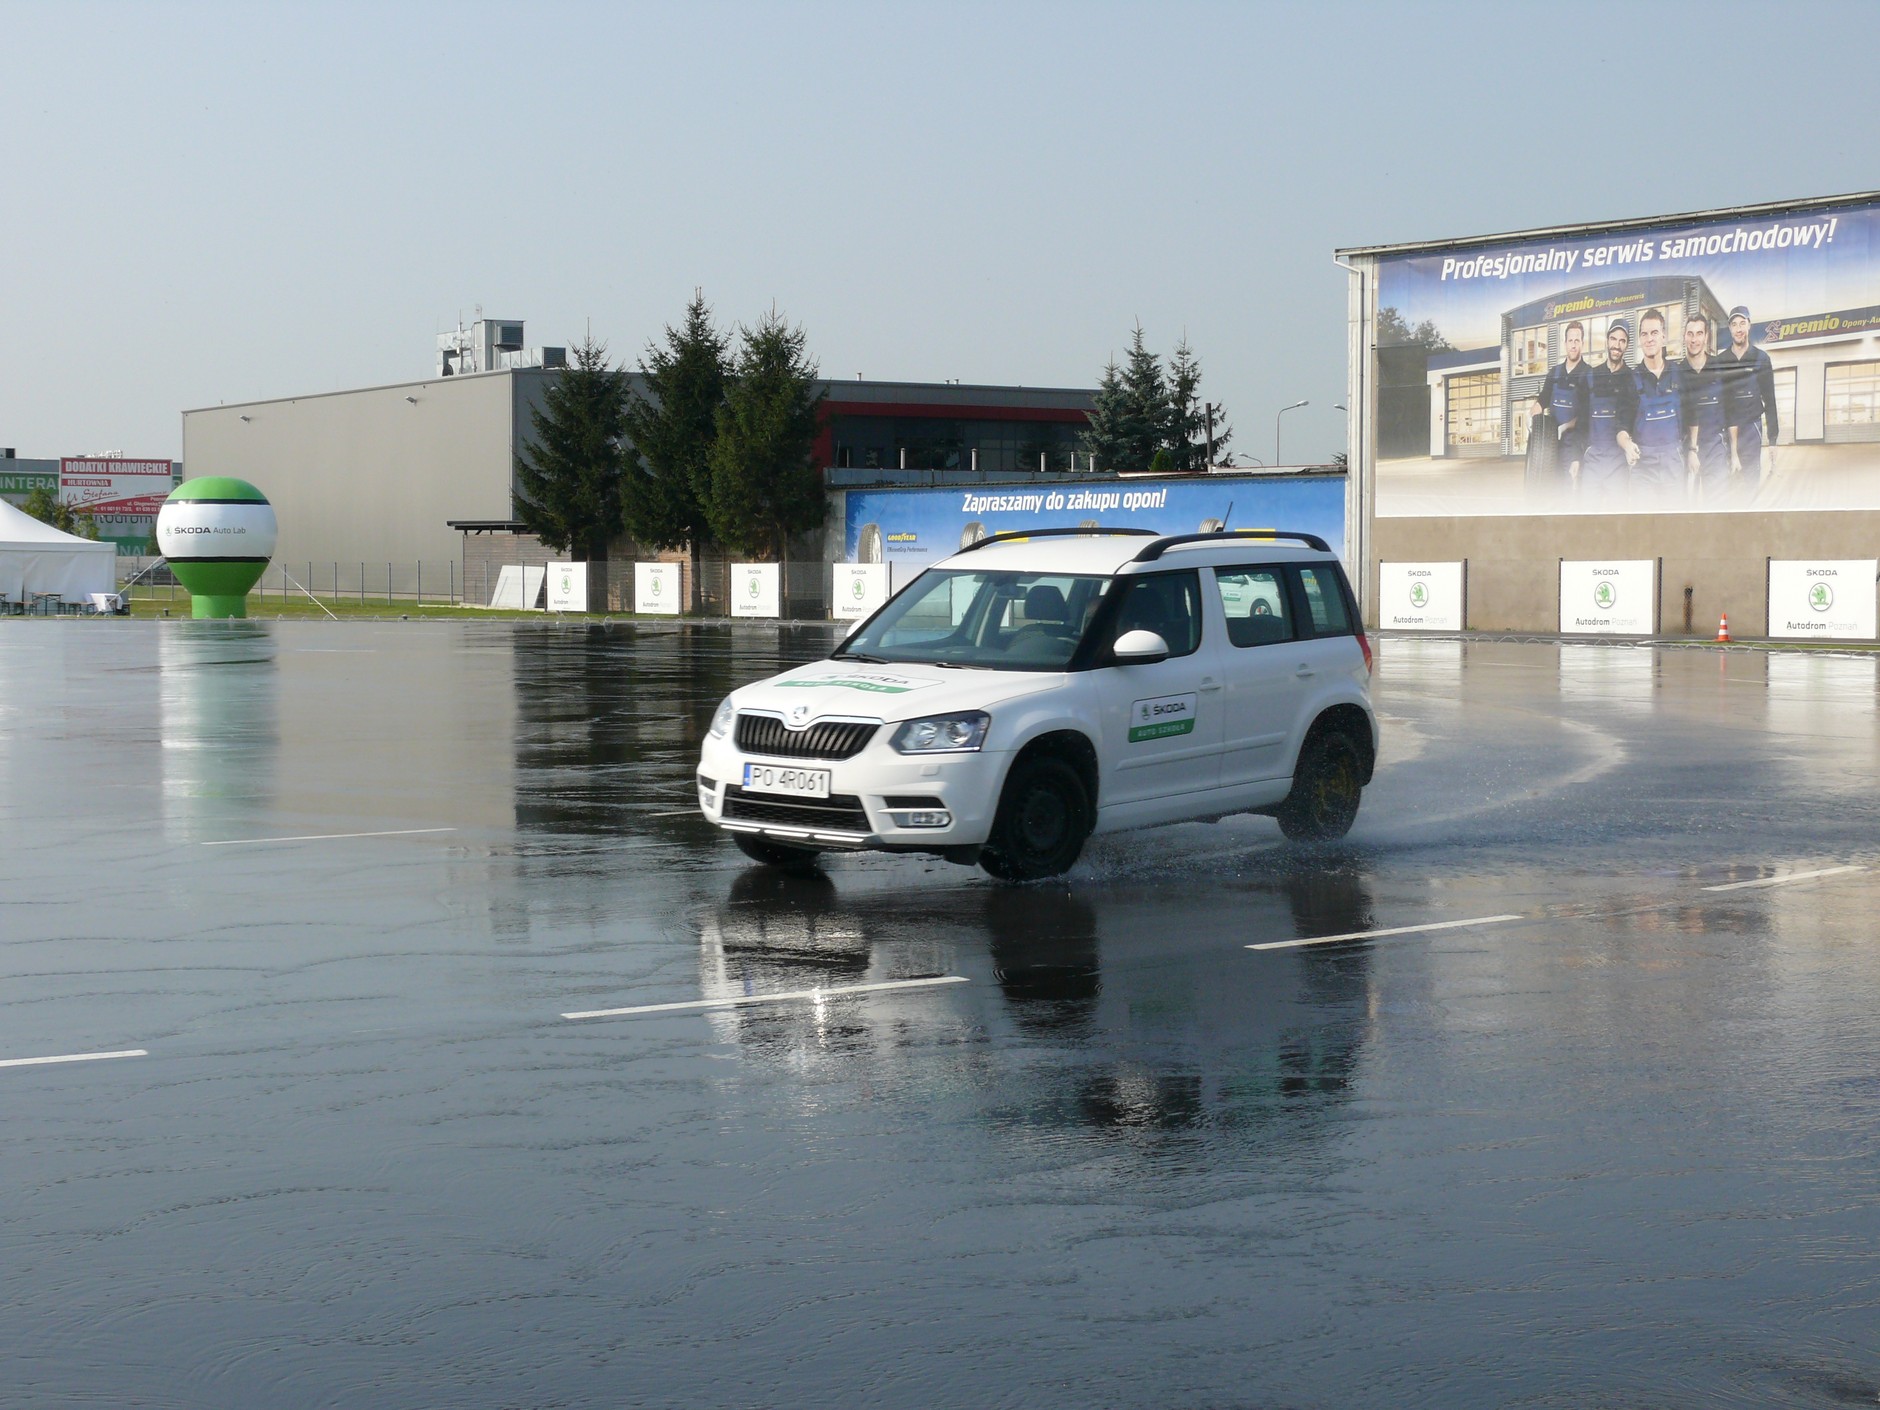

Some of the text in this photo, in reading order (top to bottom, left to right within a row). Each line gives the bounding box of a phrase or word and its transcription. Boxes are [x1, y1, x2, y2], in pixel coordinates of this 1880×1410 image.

[1441, 218, 1838, 281] Profesjonalny serwis samochodowy!
[1553, 296, 1595, 318] premio
[1778, 314, 1840, 340] premio
[65, 461, 168, 474] DODATKI KRAWIECKIE
[67, 479, 109, 487] HURTOWNIA
[962, 489, 1168, 515] Zapraszamy do zakupu opon!
[213, 527, 232, 535] Auto
[233, 527, 247, 535] Lab
[887, 532, 917, 542] GOODYEAR
[1393, 616, 1424, 624] Autodrom
[1575, 617, 1610, 626] Autodrom
[1786, 621, 1827, 630] Autodrom
[752, 767, 825, 792] PO 4R061
